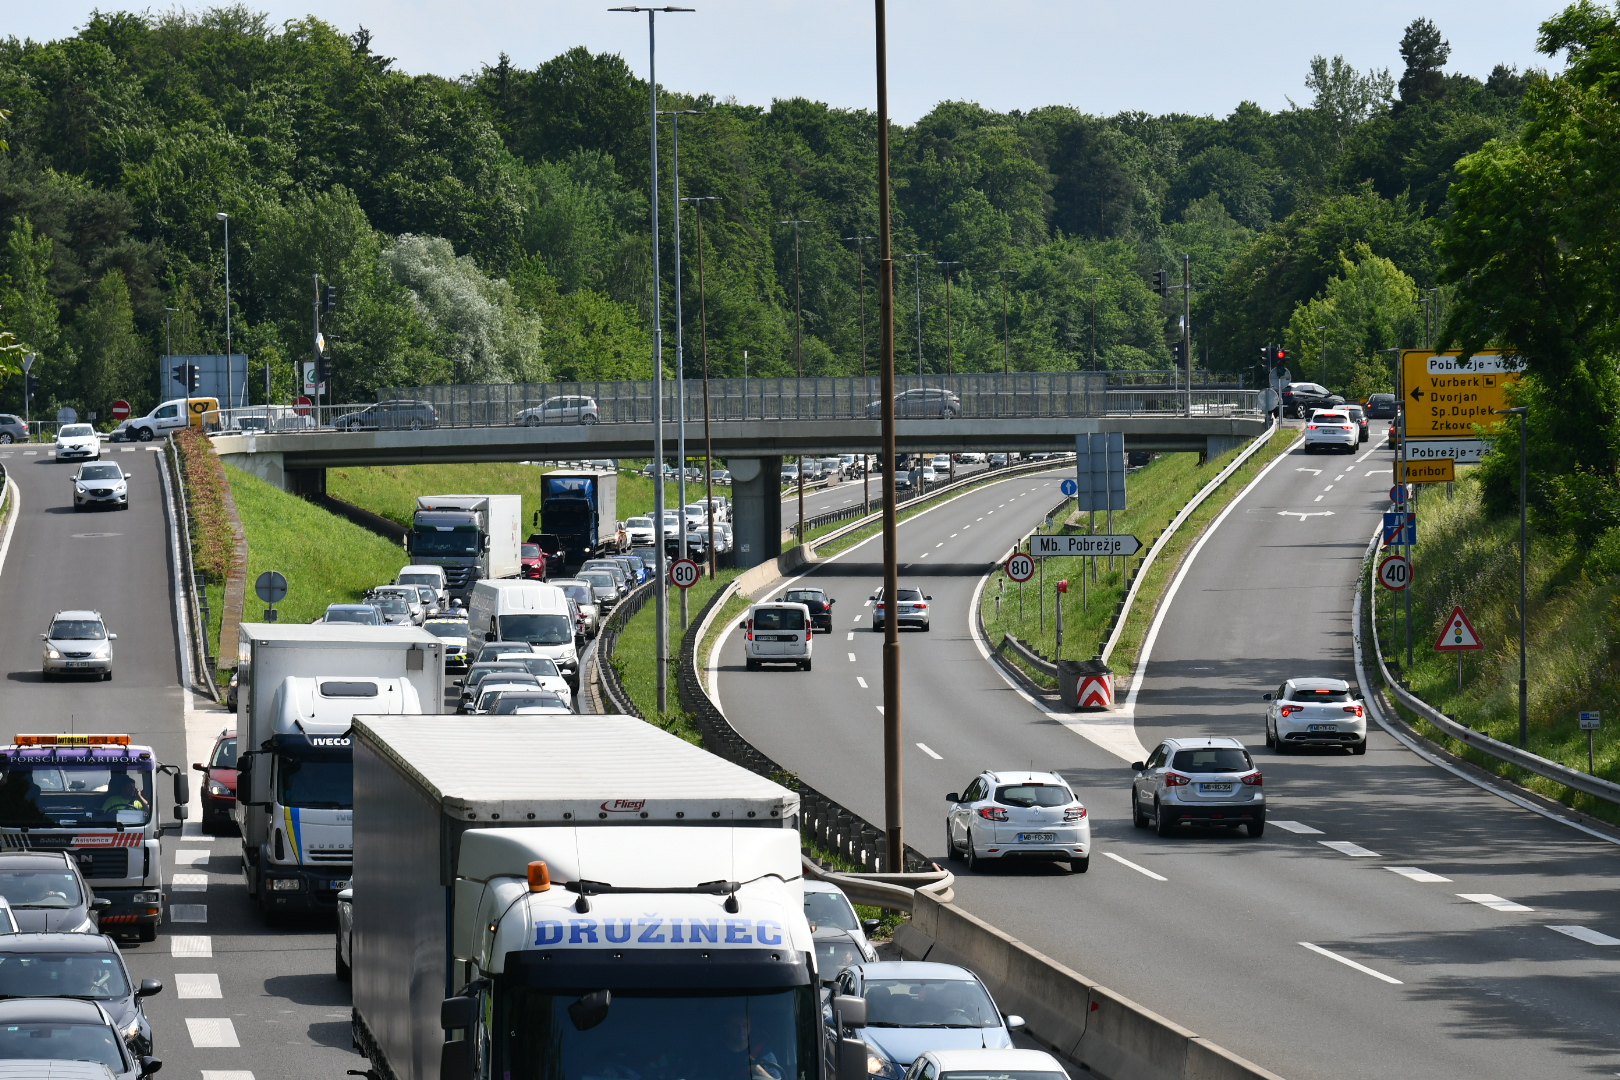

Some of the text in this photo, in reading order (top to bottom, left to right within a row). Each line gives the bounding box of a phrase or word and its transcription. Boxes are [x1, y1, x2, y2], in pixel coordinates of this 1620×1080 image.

[1431, 377, 1479, 387] Vurberk
[1431, 392, 1477, 403] Dvorjan
[1431, 420, 1472, 430] Zrkovc
[1412, 447, 1491, 459] Pobrežje-za
[1040, 538, 1121, 555] Mb. Pobrežje
[1011, 560, 1028, 575] 80
[1385, 565, 1406, 582] 40
[675, 566, 693, 582] 80
[313, 737, 351, 746] IVECO
[613, 799, 646, 810] Fliegl
[533, 913, 783, 947] DRUŽINEC
